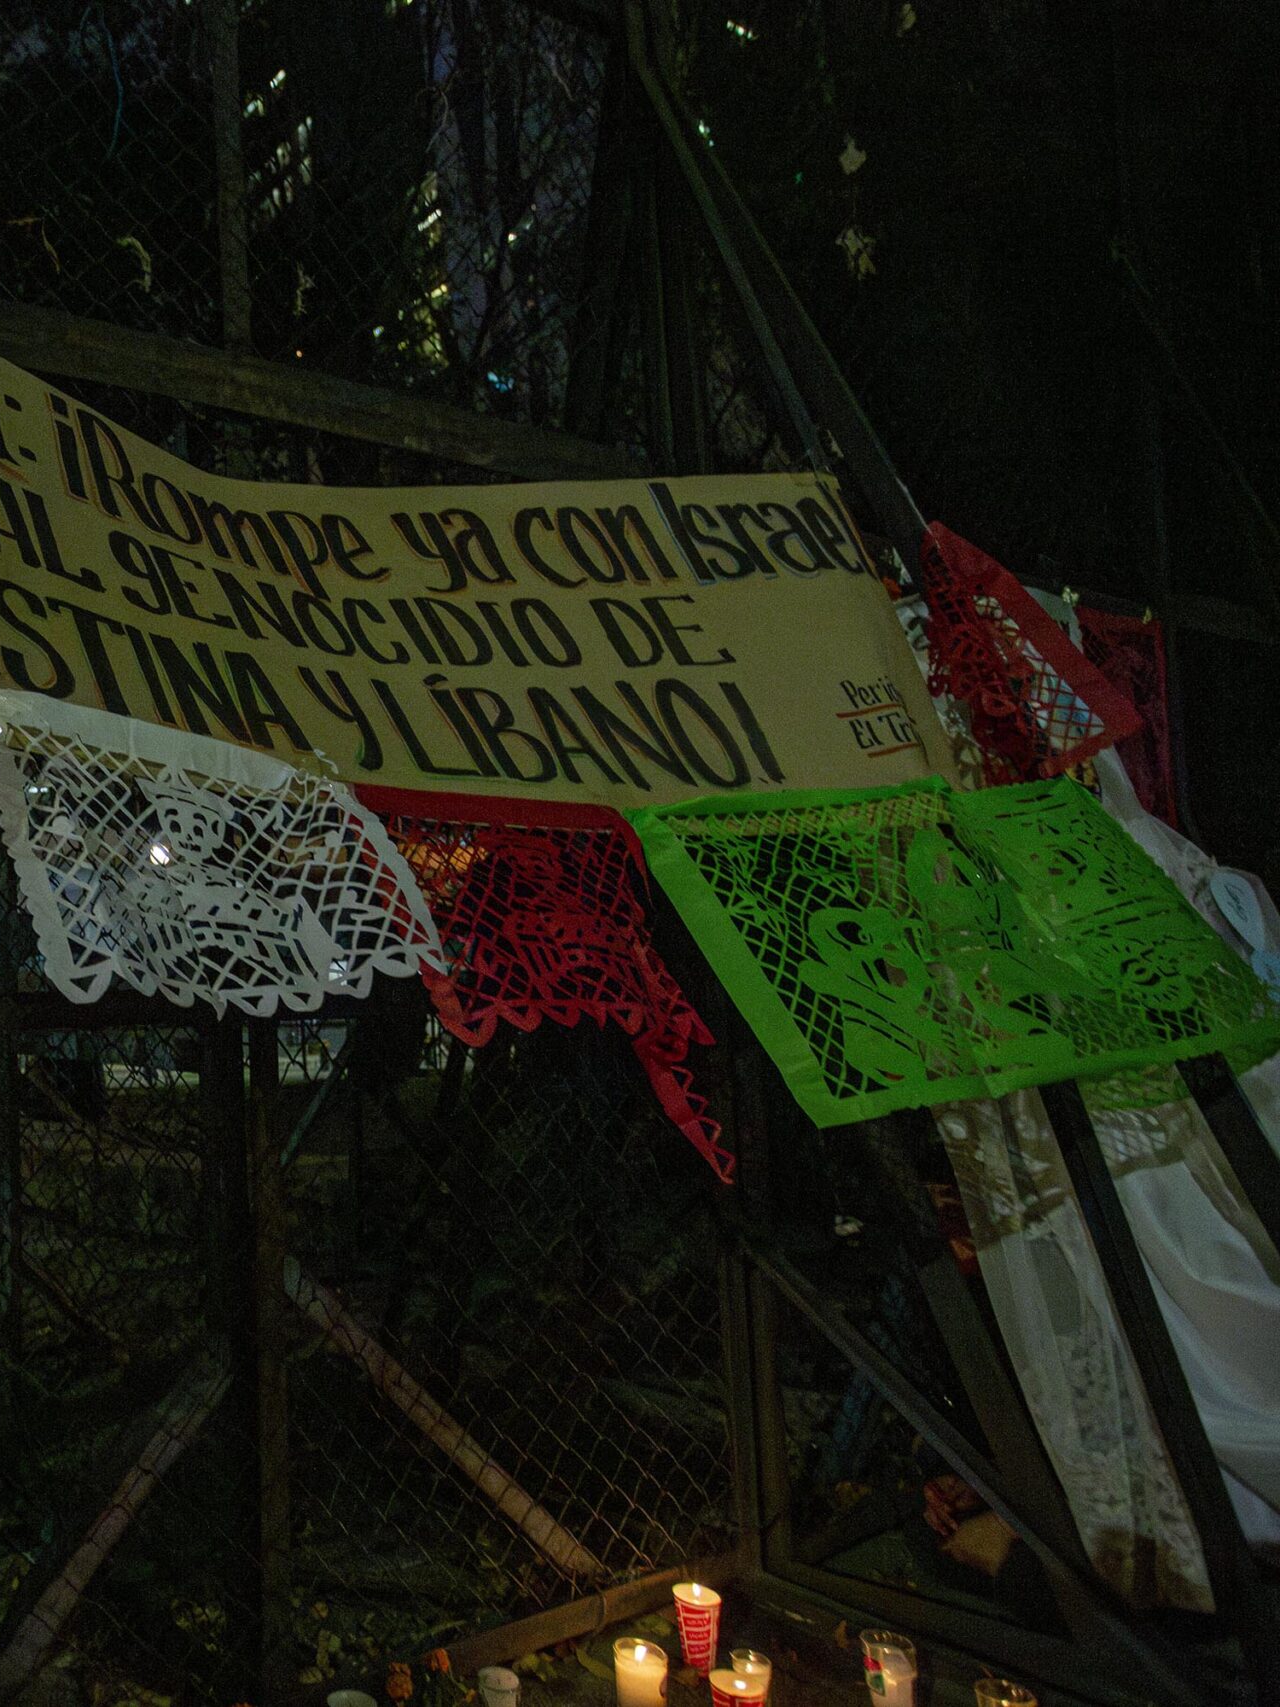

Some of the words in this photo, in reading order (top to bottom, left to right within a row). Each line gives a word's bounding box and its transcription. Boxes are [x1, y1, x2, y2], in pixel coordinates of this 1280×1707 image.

[48, 393, 391, 601] ¡Rompe
[392, 508, 517, 593] ya
[514, 505, 680, 588] con
[646, 481, 878, 586] Israel
[590, 595, 736, 668] DE
